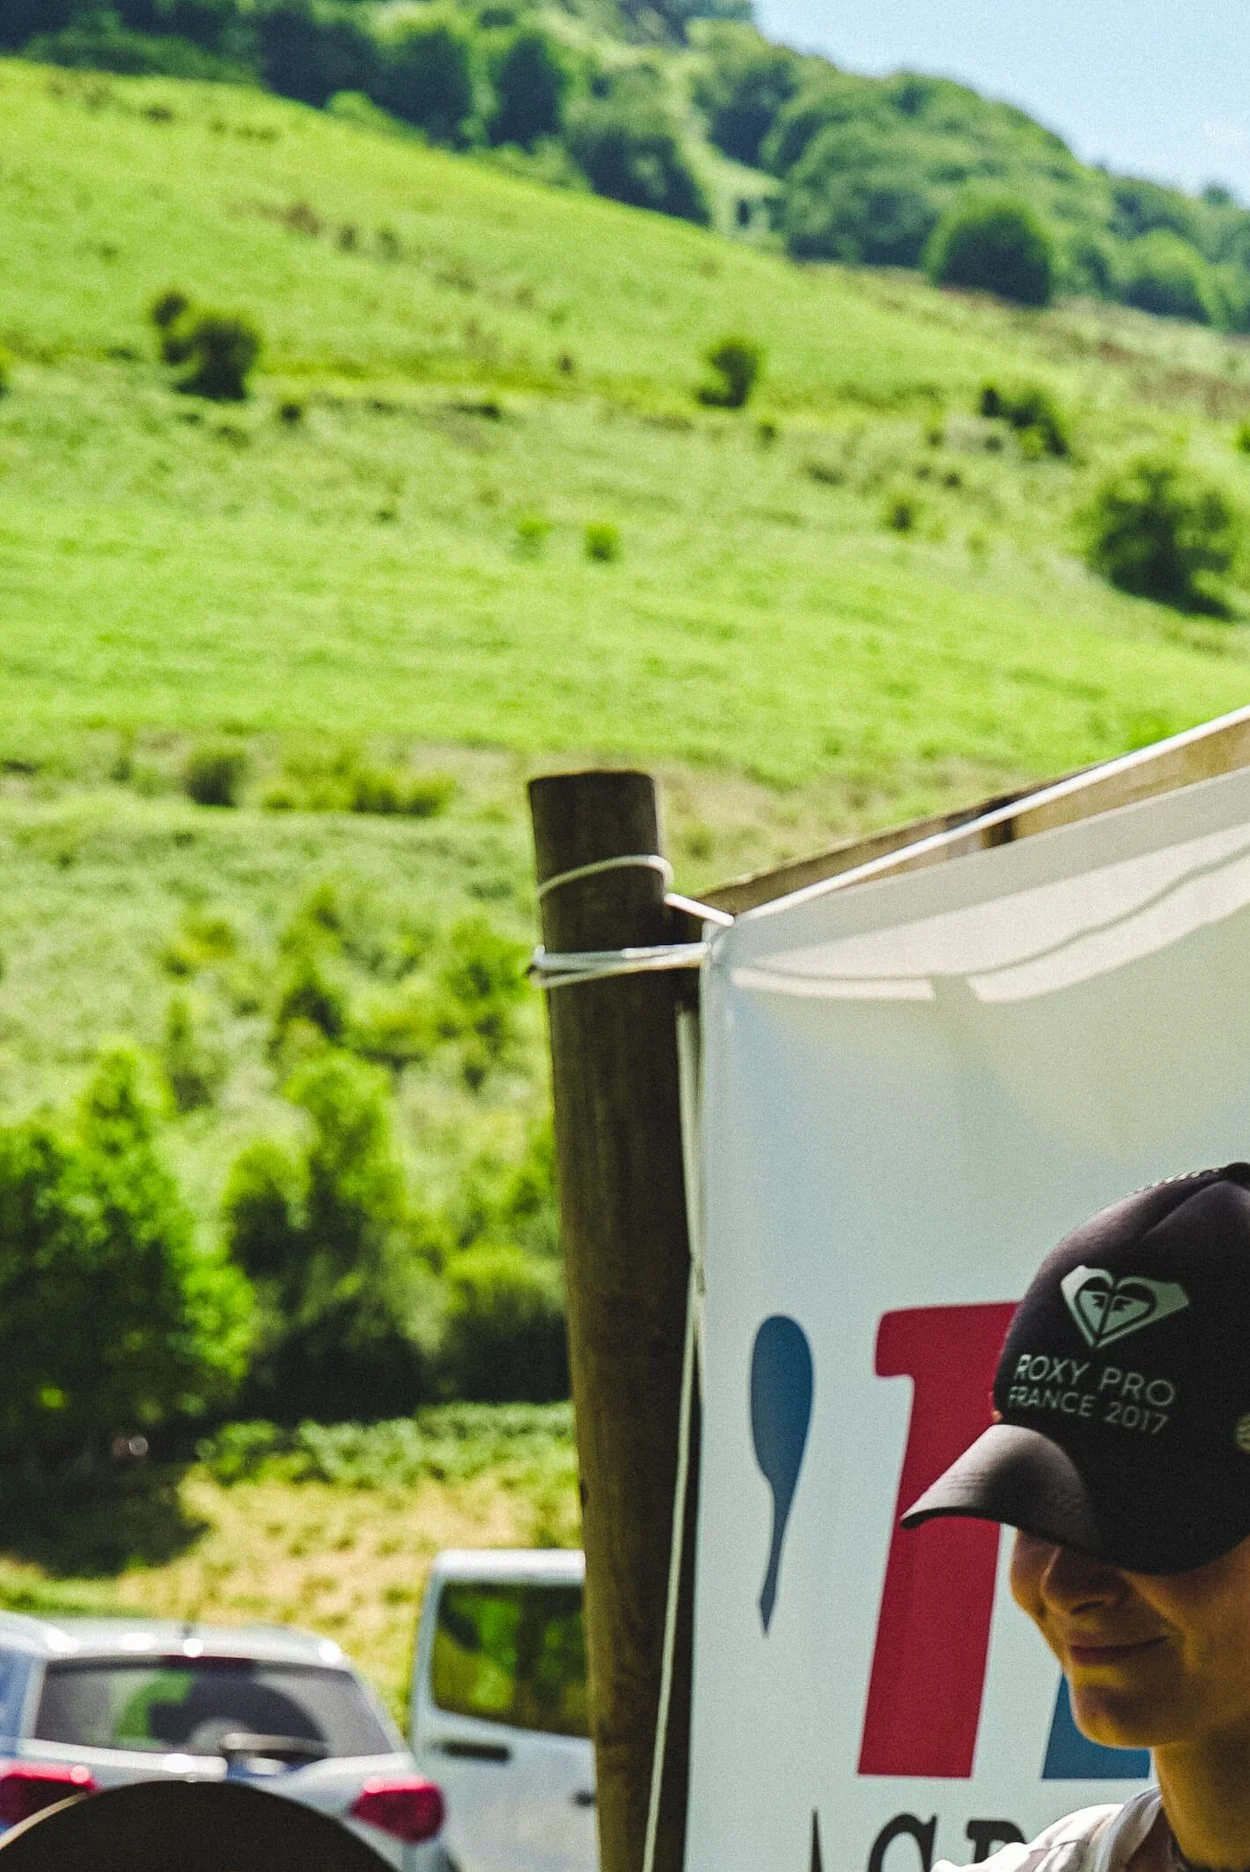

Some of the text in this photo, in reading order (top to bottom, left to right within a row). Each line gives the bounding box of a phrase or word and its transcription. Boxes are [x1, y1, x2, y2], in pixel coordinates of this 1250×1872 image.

[1014, 1353, 1176, 1407] ROXY PRO
[1007, 1385, 1169, 1435] FRANCE 2017
